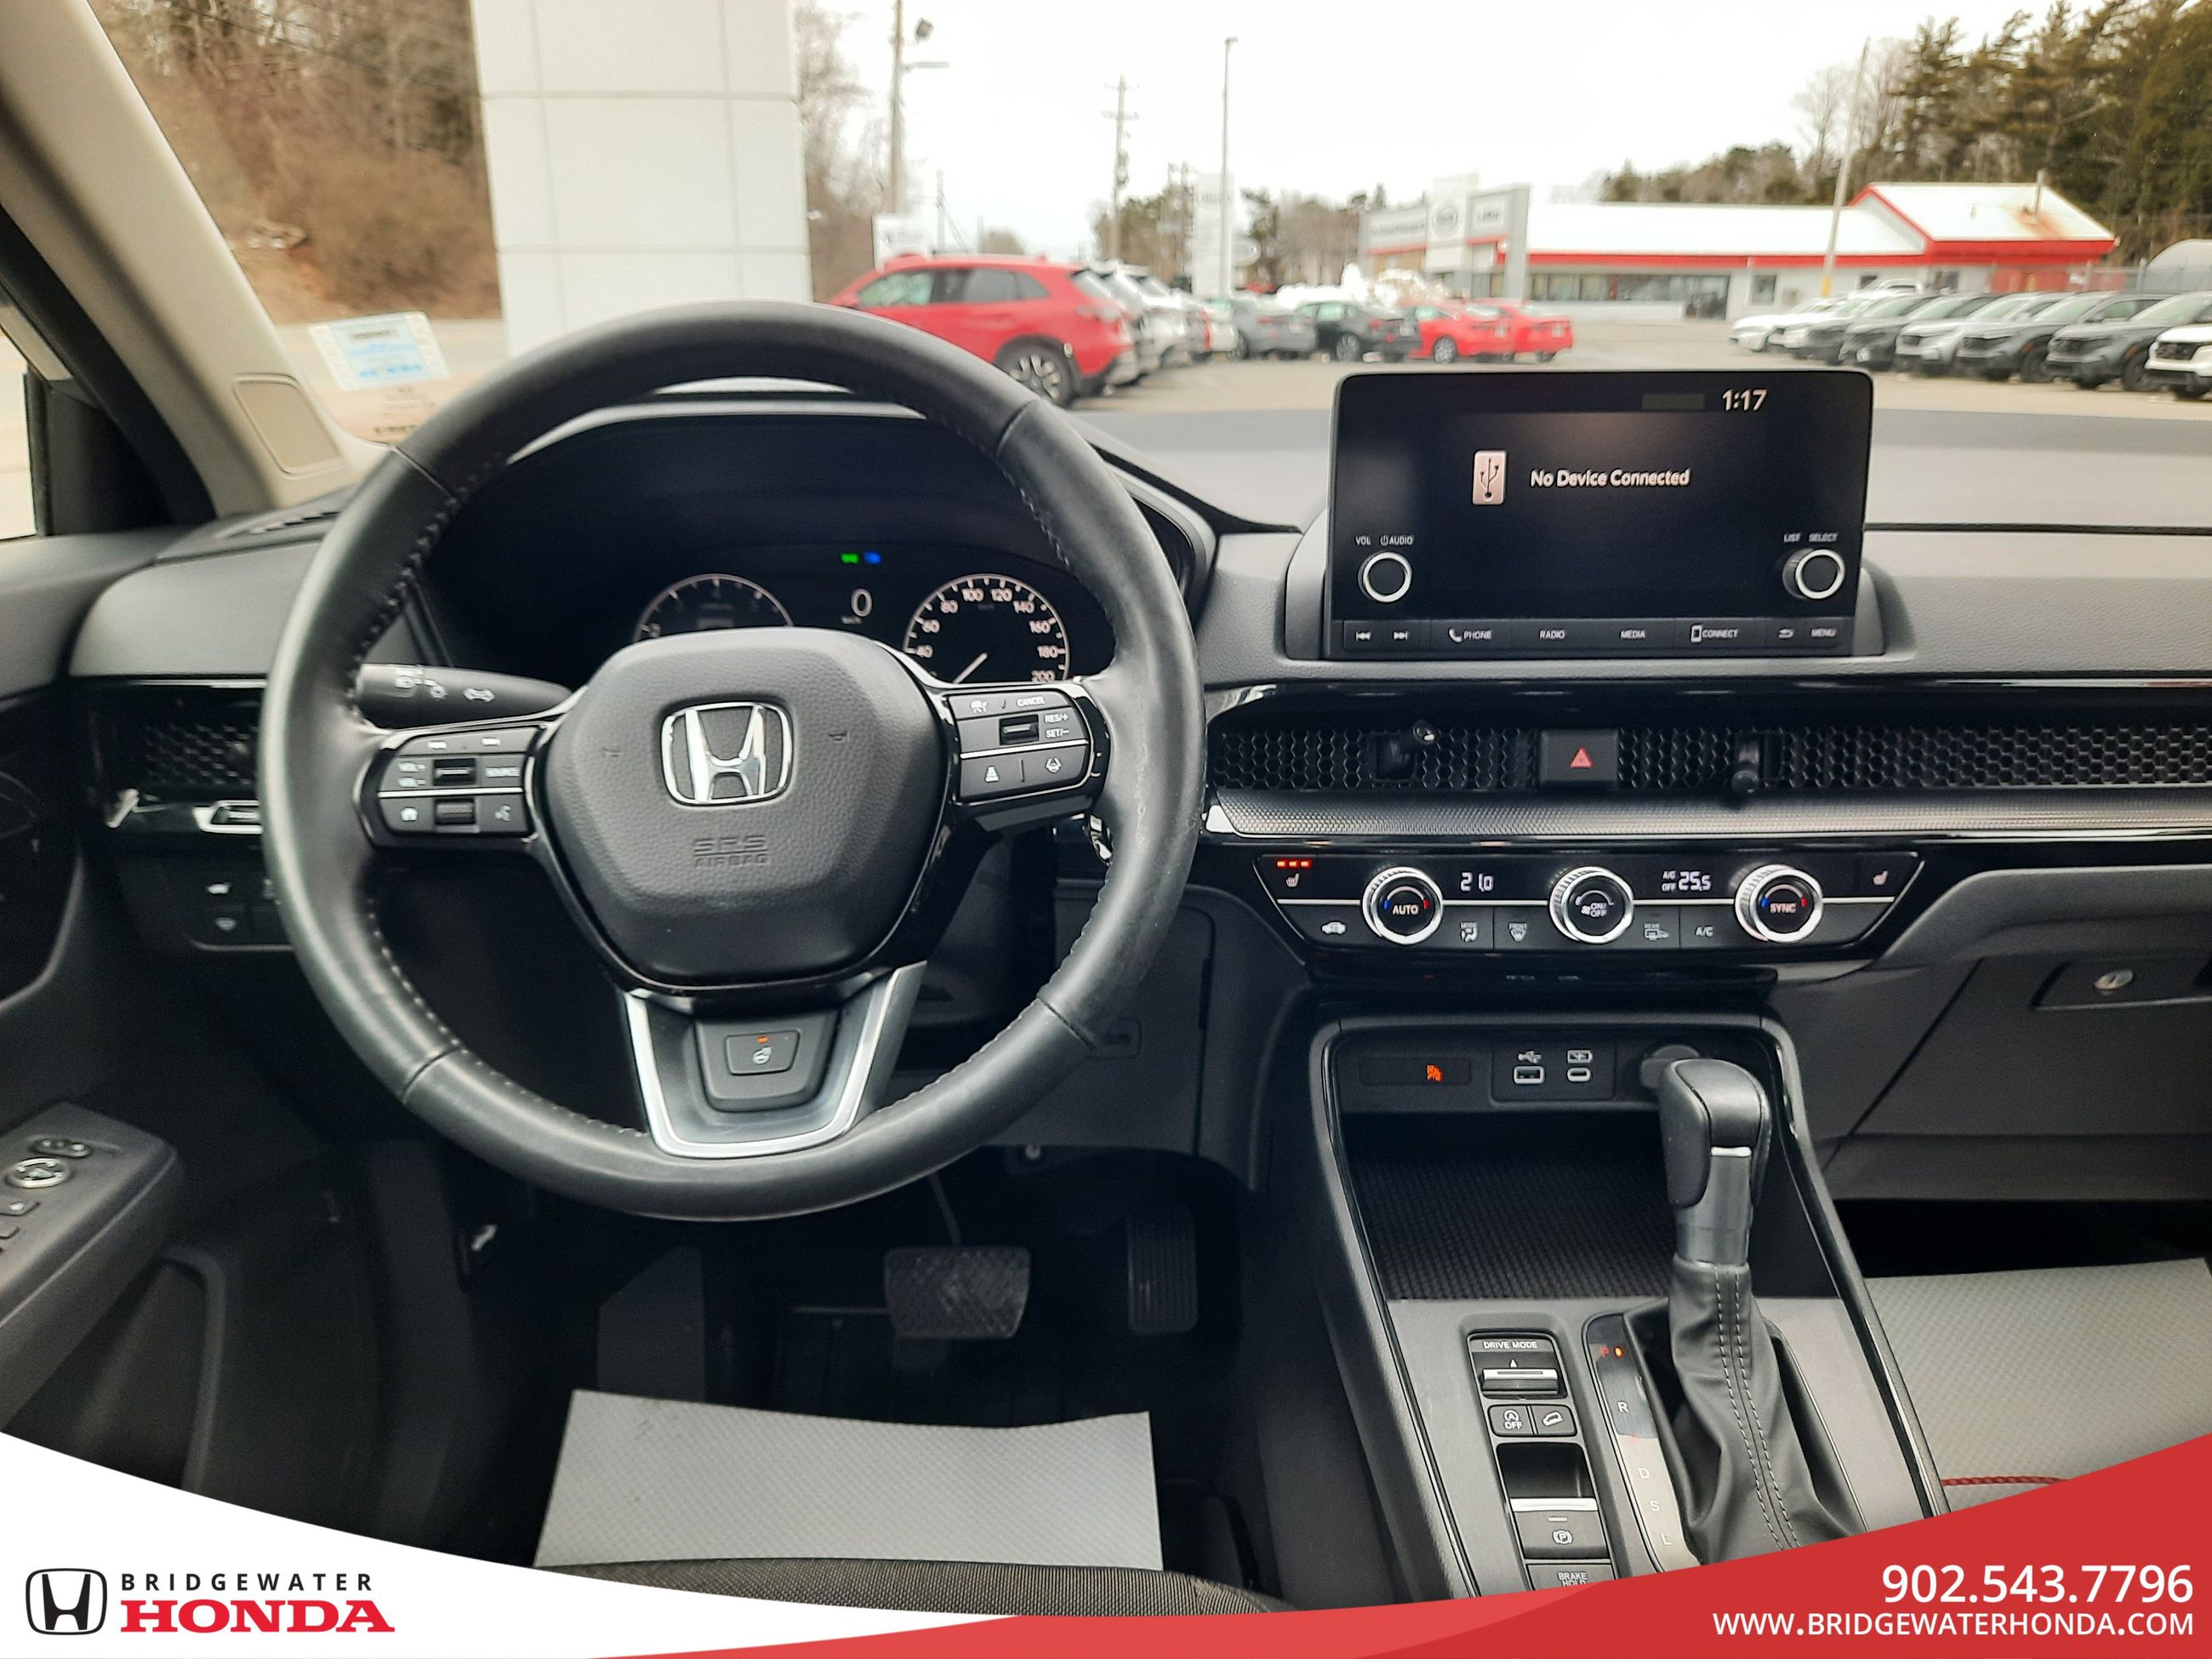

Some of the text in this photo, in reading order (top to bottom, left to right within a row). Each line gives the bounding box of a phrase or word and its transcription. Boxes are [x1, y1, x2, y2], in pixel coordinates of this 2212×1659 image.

[1722, 389, 1767, 411] 1:17
[1531, 469, 1690, 487] No Device Connected
[1355, 536, 1371, 545] VOL
[961, 588, 984, 602] 100
[990, 588, 1012, 602] 120
[851, 588, 872, 617] 0
[1463, 630, 1491, 640] PHONE
[1539, 630, 1566, 640] RADIO
[1621, 630, 1645, 639] MEDIA
[1702, 630, 1738, 638] CONNECT
[1016, 696, 1046, 708] CANCEL
[1392, 905, 1419, 915] AUTO
[1770, 903, 1797, 914] SYNC
[1696, 926, 1713, 937] A/C
[1483, 1341, 1538, 1349] DRIVE MODE
[1617, 1401, 1630, 1413] R
[1504, 1421, 1523, 1430] OFF
[1639, 1468, 1650, 1479] D
[1650, 1500, 1660, 1512] S
[1661, 1533, 1673, 1545] L
[1558, 1571, 1588, 1581] BRAKE
